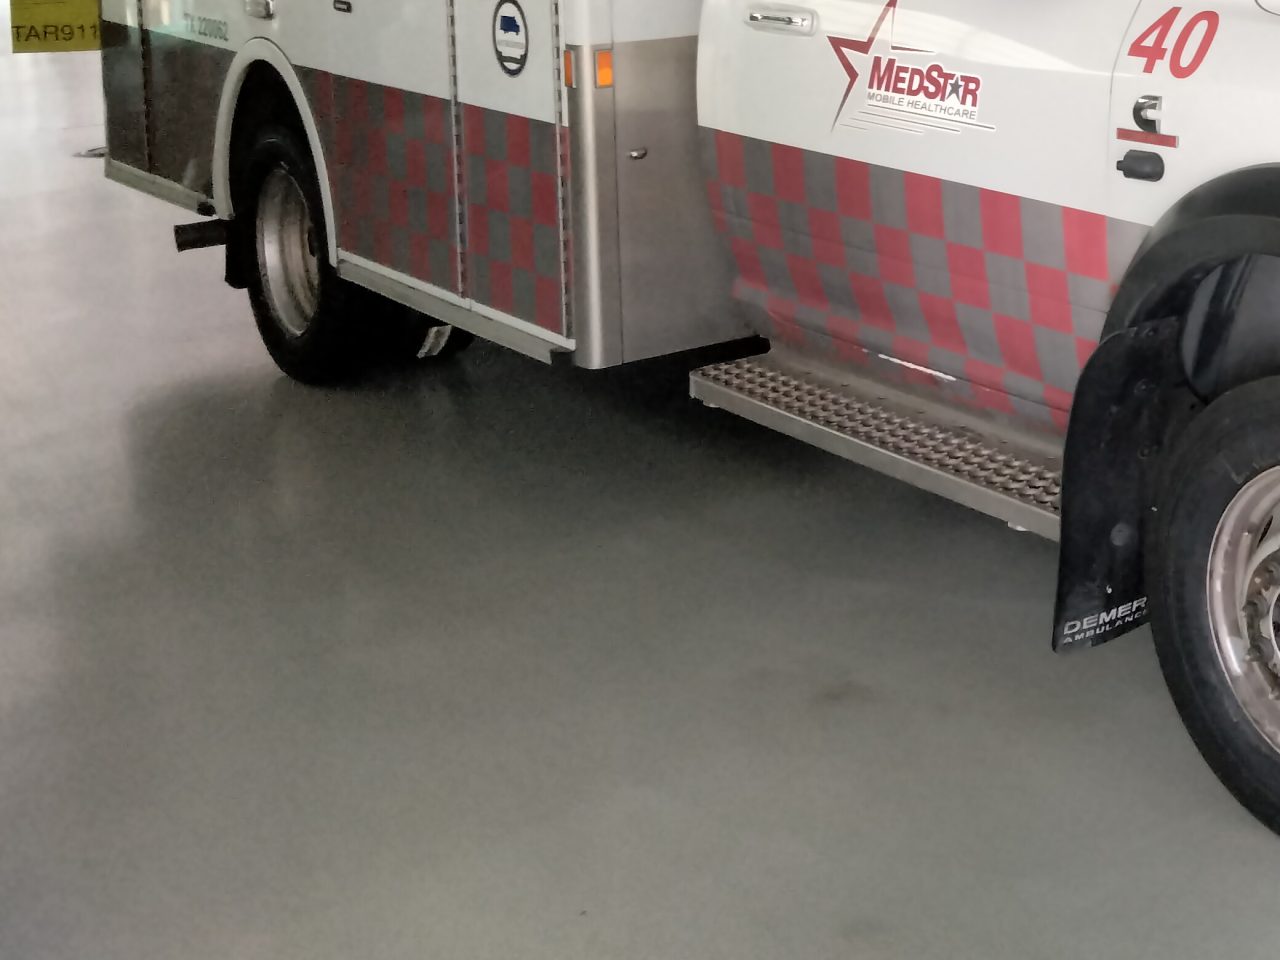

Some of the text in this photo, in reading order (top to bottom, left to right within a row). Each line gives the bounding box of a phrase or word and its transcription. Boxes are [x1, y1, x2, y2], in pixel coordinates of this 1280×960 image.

[1127, 6, 1220, 79] 40
[867, 91, 977, 121] MOBILE HEALTHCARE
